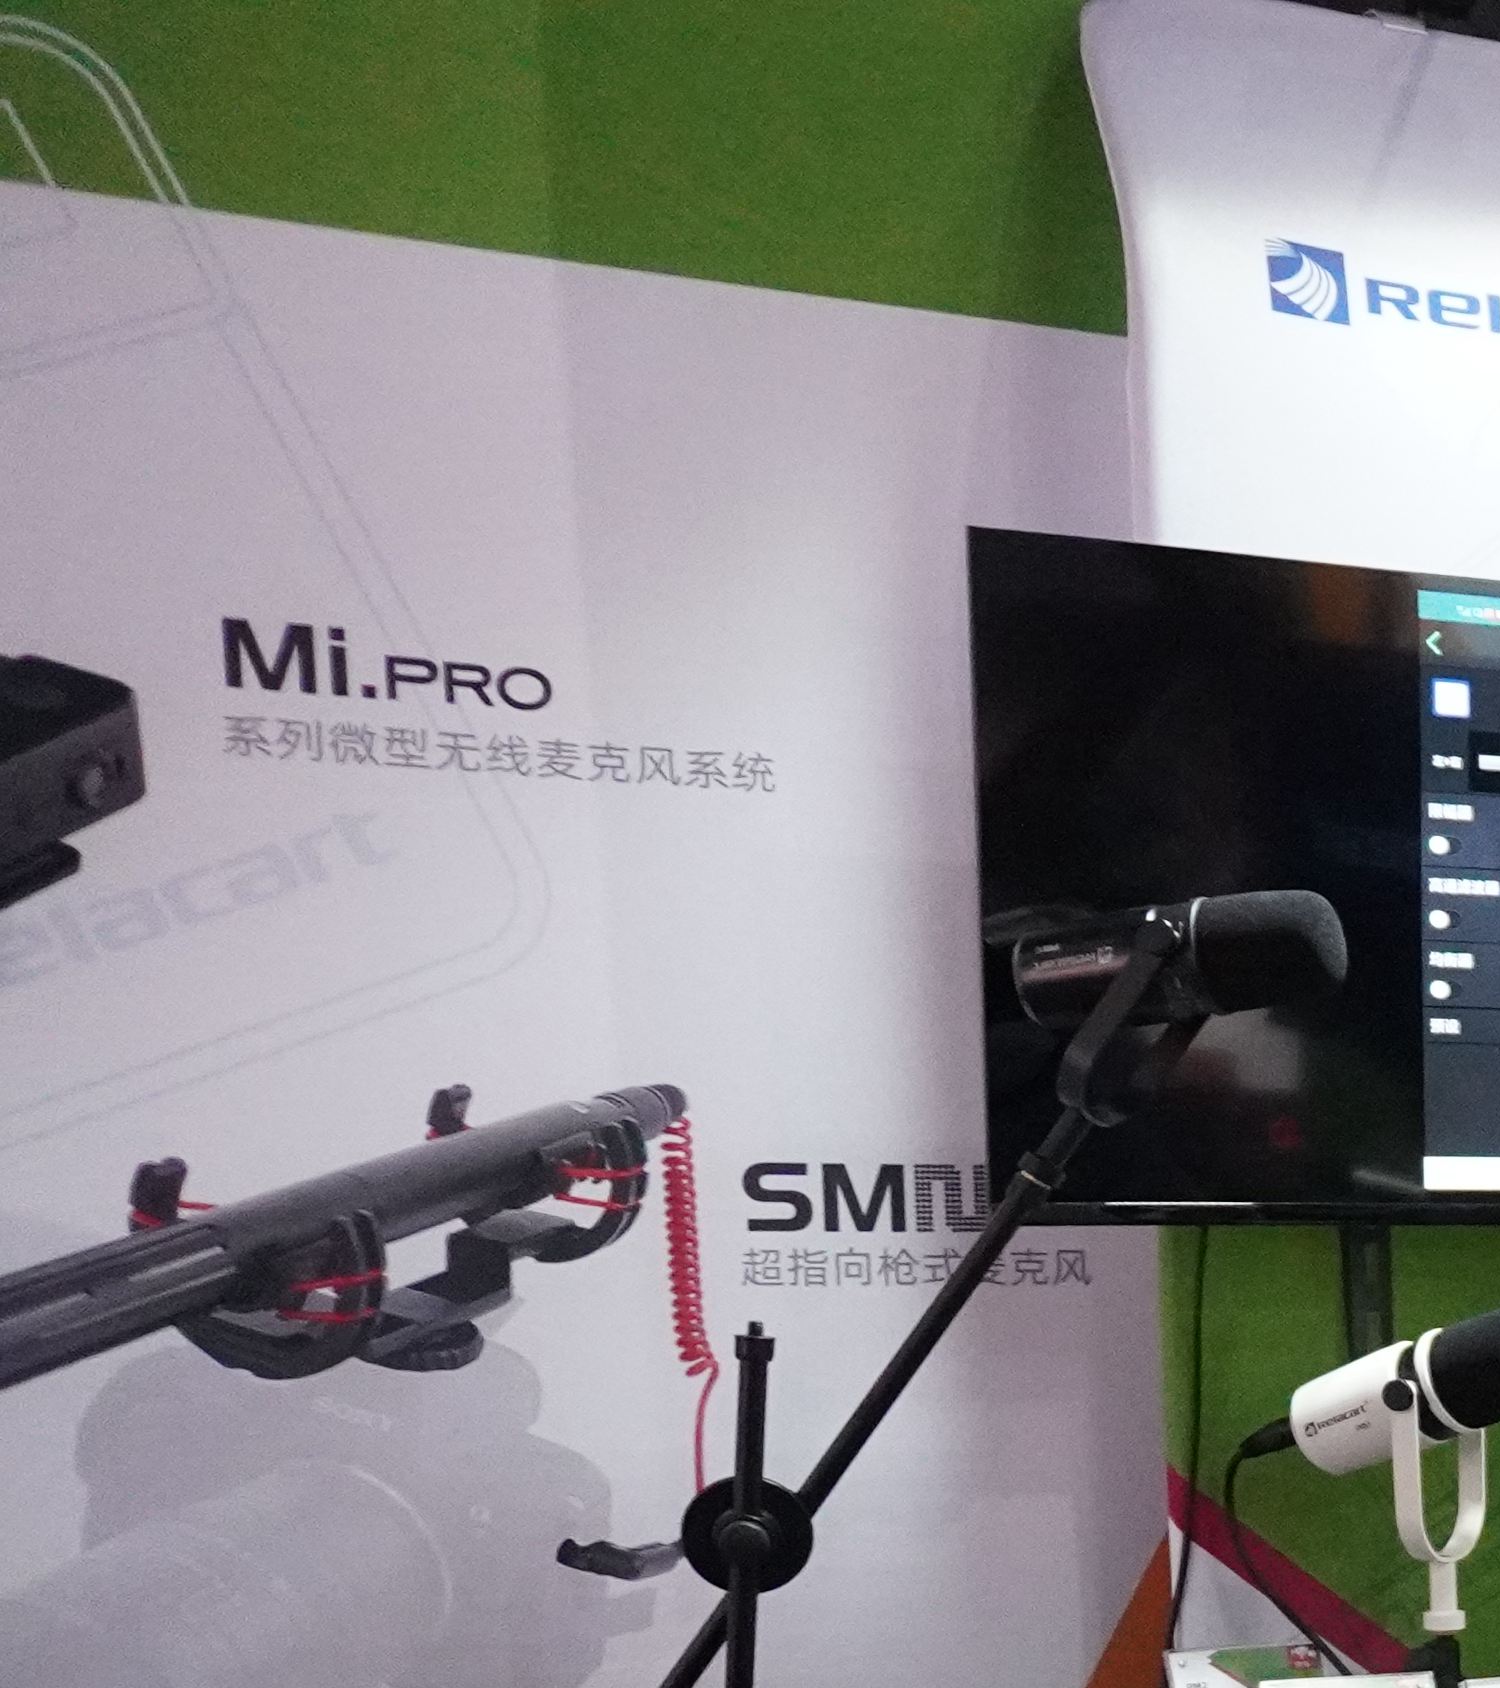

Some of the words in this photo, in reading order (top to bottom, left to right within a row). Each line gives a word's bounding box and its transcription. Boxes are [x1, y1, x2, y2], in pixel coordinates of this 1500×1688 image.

[221, 714, 777, 794] 系列微型无线麦克风系统
